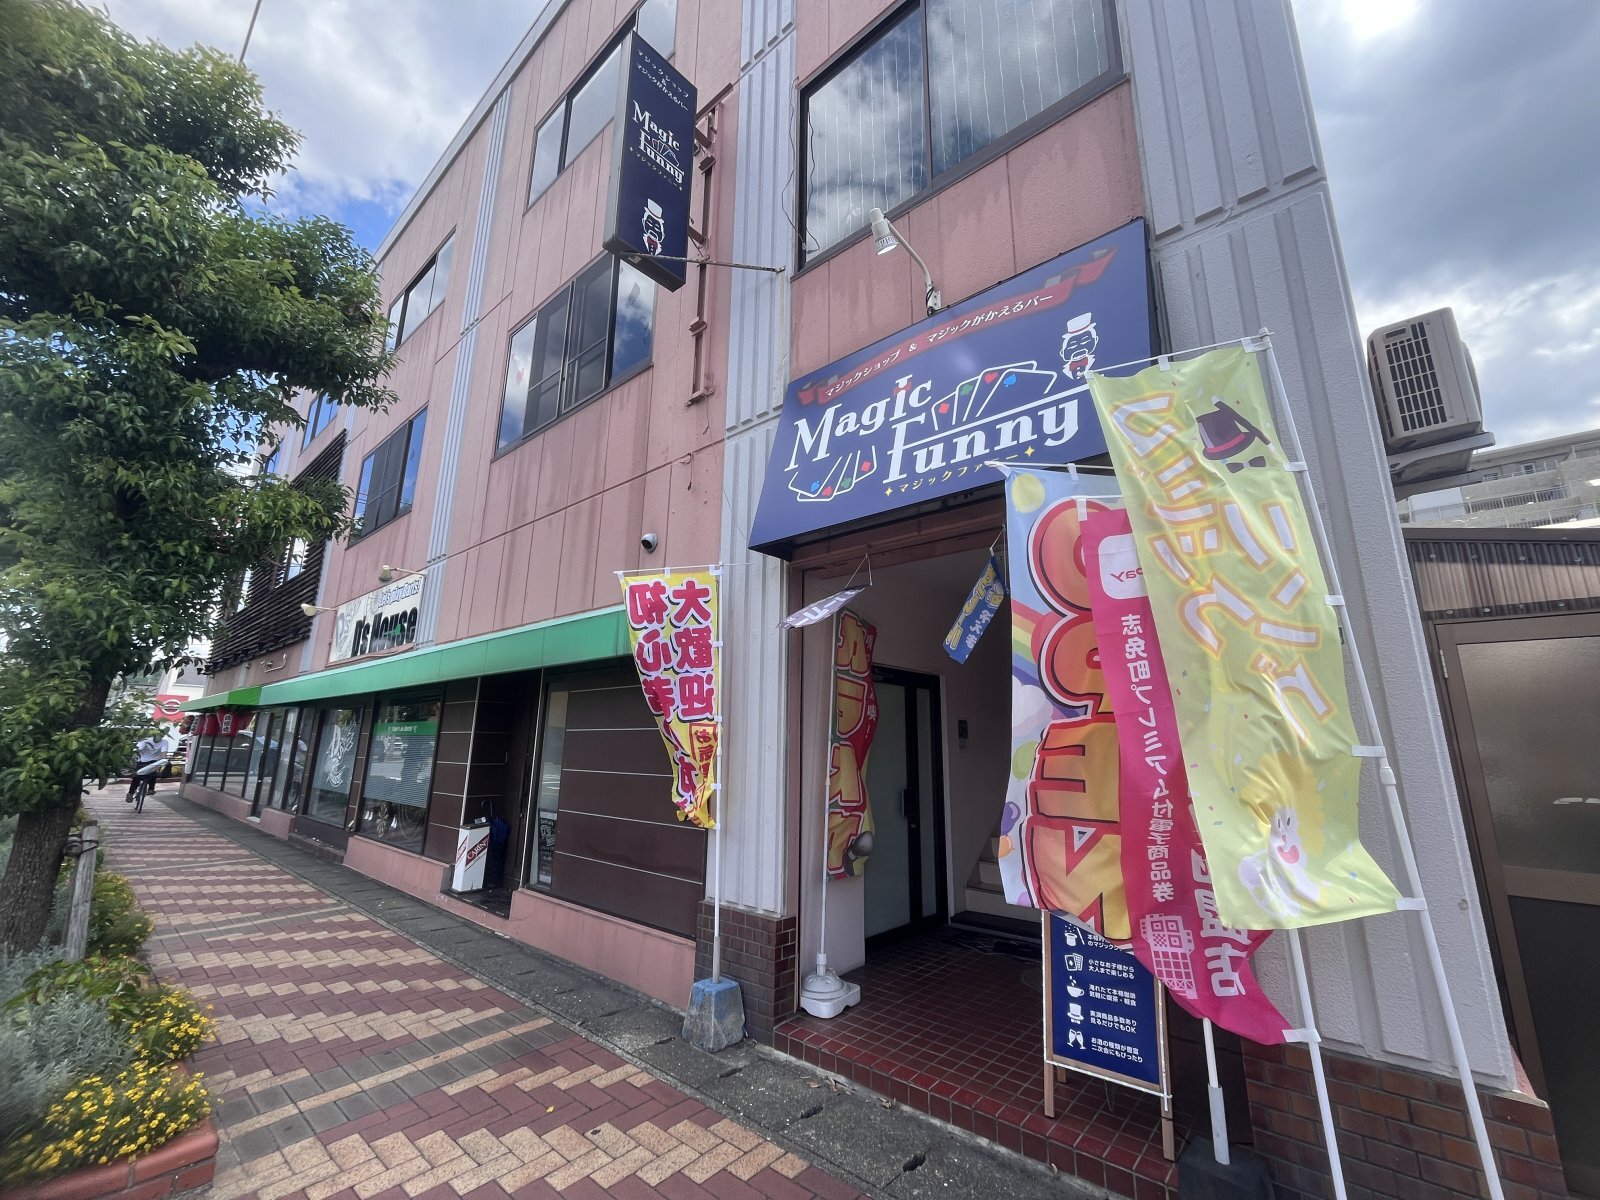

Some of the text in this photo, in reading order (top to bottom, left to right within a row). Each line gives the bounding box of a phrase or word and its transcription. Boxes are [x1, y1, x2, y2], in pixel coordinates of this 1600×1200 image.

[632, 100, 680, 151] Magic
[639, 129, 685, 184] Funny
[825, 294, 1054, 397] マジックショップ & マジックがかえるバー
[784, 374, 932, 472] Magic
[882, 392, 1082, 485] Funny
[1088, 959, 1135, 973] 小さなお子様から
[1088, 966, 1135, 980] 大人まで楽しめる
[1090, 1017, 1137, 1034] 見るだけでもOK
[1091, 1037, 1139, 1055] お酒の種類が豊富
[1091, 1044, 1143, 1063] 二次会にもぴったり
